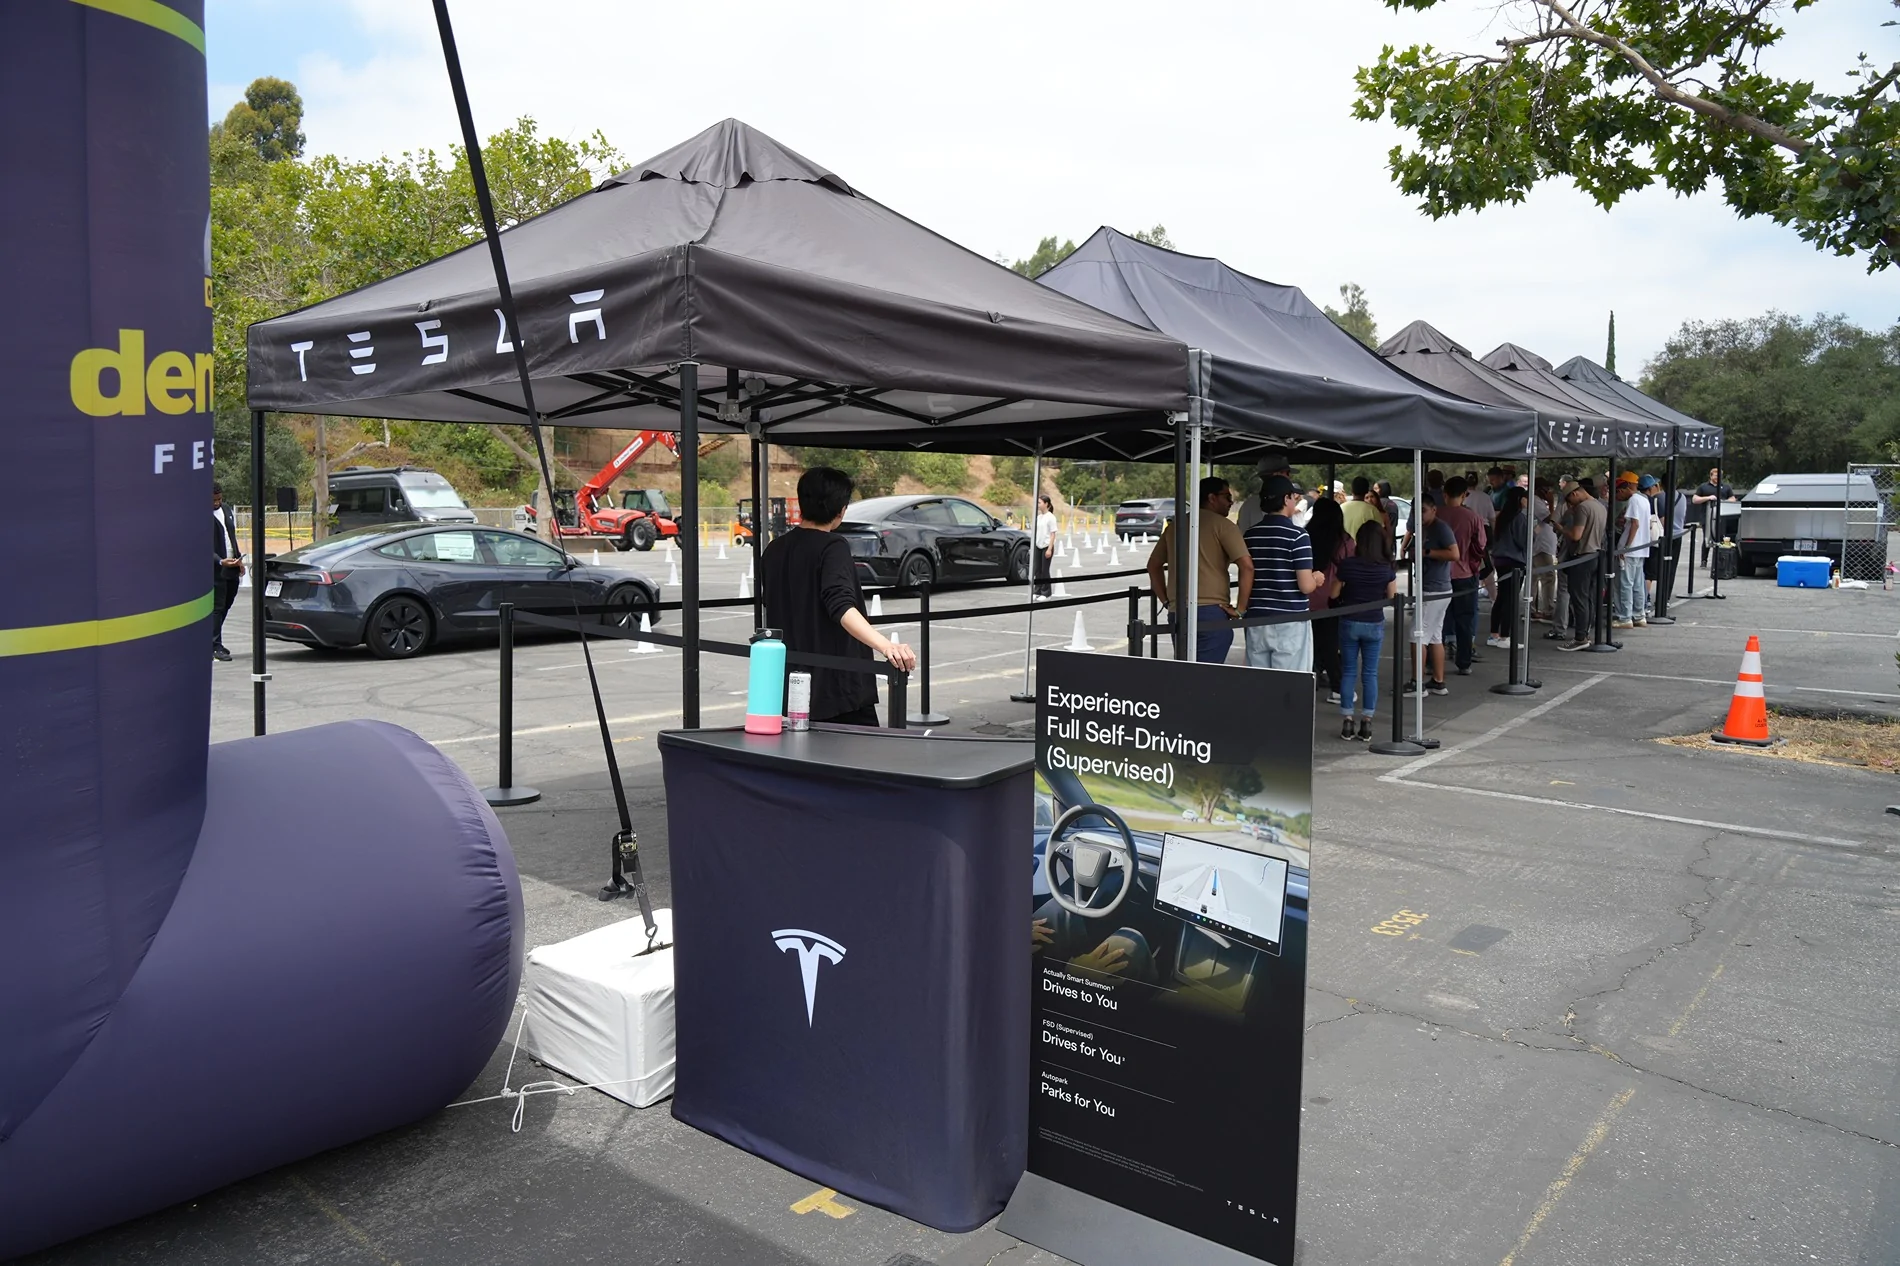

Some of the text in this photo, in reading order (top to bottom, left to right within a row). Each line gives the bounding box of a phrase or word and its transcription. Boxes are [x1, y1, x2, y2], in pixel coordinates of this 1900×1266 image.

[291, 289, 606, 381] TESLA
[1549, 421, 1609, 445] TESLA
[1624, 431, 1667, 448] TESLA
[1684, 432, 1719, 449] TESLA
[1047, 685, 1161, 719] Experience
[1047, 716, 1211, 763] Full Self-Driving
[1047, 745, 1174, 788] (Supervised)
[1043, 967, 1066, 980] Actually
[1066, 973, 1084, 985] Smart
[1043, 978, 1118, 1010] Drives to You
[1042, 1019, 1094, 1040] FSD (Supervised)
[1042, 1030, 1078, 1052] Drives
[1080, 1041, 1097, 1057] for
[1041, 1071, 1069, 1085] Autopark
[1041, 1082, 1116, 1118] Parks for You
[1226, 1199, 1279, 1224] TESLA
